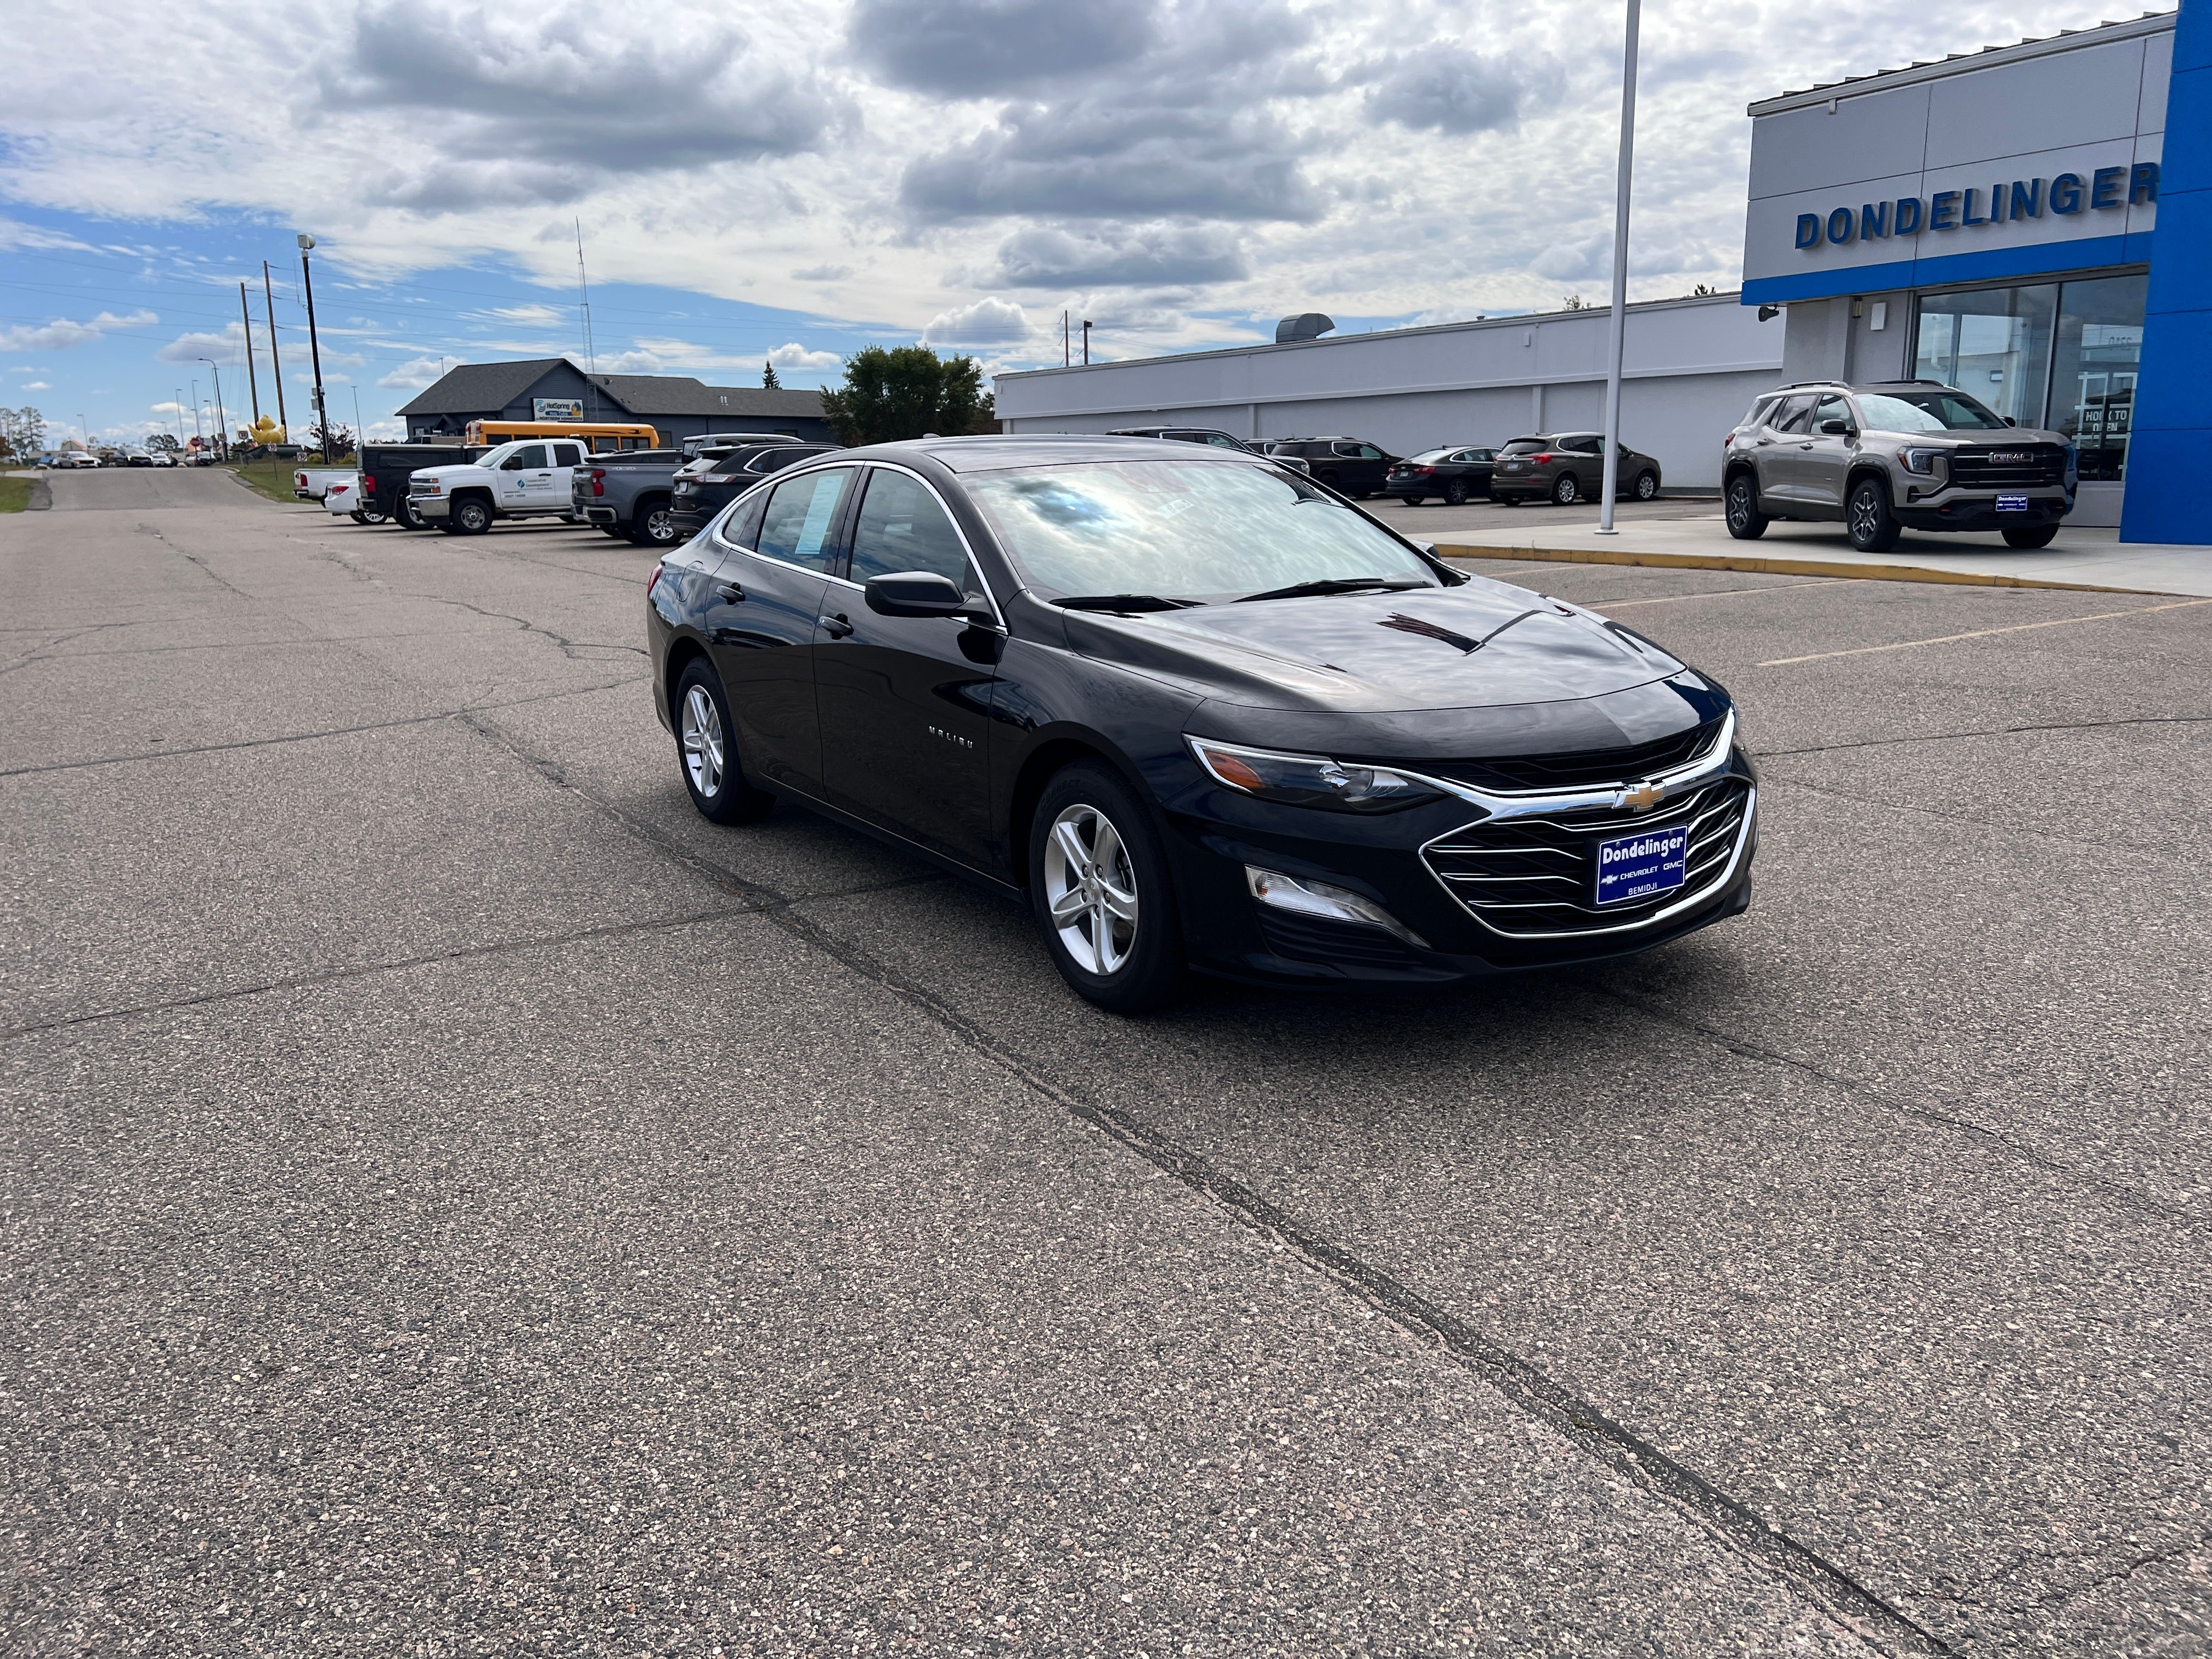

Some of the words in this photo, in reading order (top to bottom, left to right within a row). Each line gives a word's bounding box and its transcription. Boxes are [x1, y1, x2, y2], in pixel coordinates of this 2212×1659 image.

[1795, 162, 2159, 250] DONDELINGER
[2114, 410, 2128, 420] TO
[2092, 422, 2118, 432] OEN
[1994, 454, 2032, 462] GMC
[929, 725, 973, 749] MALIBU
[1602, 836, 1684, 865] Dondelinger
[1620, 865, 1659, 880] CHEVROLET
[1663, 860, 1683, 871] GMC
[1628, 882, 1657, 896] BEMIDJI
